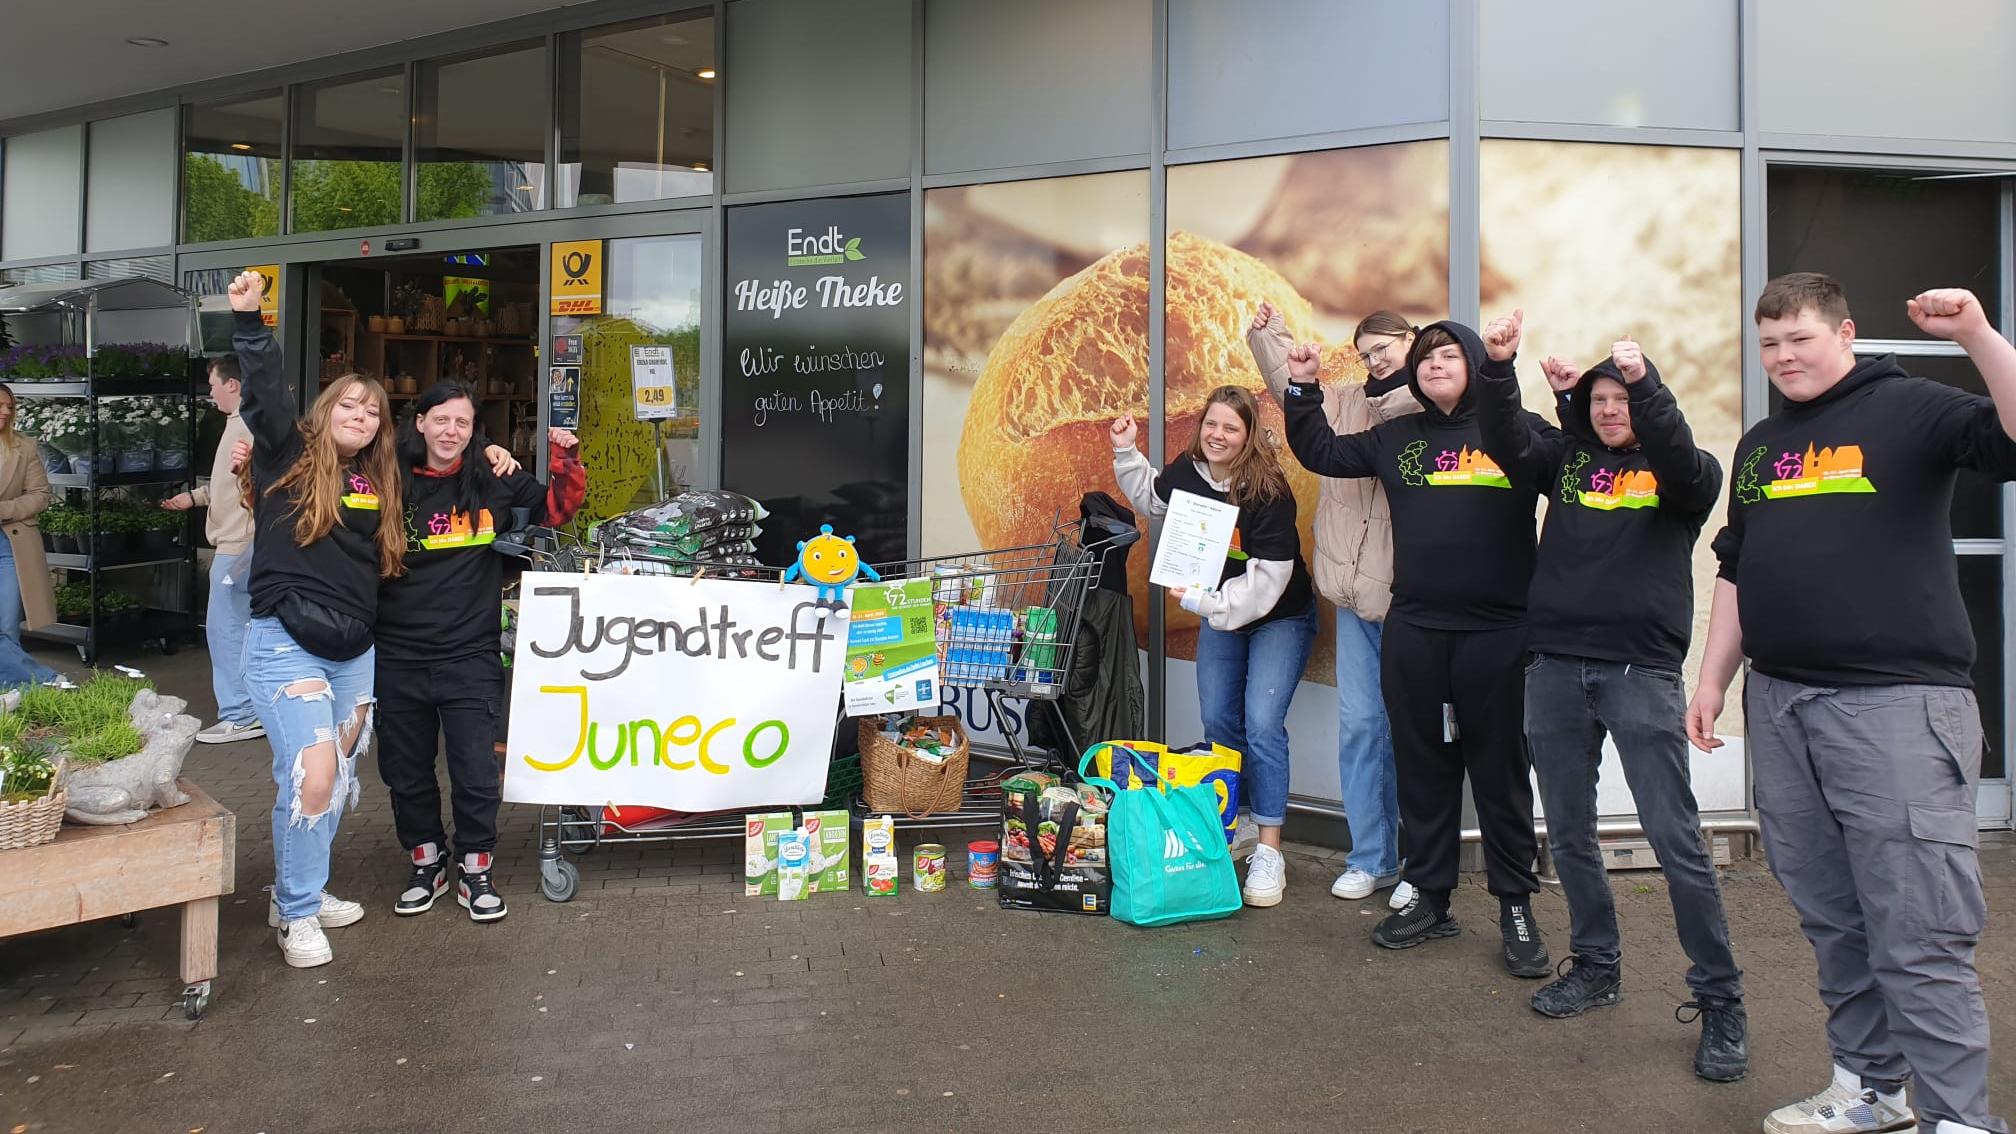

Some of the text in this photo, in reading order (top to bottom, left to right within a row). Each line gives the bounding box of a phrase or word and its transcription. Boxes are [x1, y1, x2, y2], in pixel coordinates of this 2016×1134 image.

[788, 226, 845, 256] Endt
[558, 300, 595, 312] DHL
[734, 275, 904, 319] Heiße Theke
[740, 345, 885, 377] Wir wünschen
[754, 389, 802, 427] guten
[1782, 465, 1802, 480] 72
[530, 586, 835, 681] Jugendtreff
[523, 685, 790, 775] Juneco
